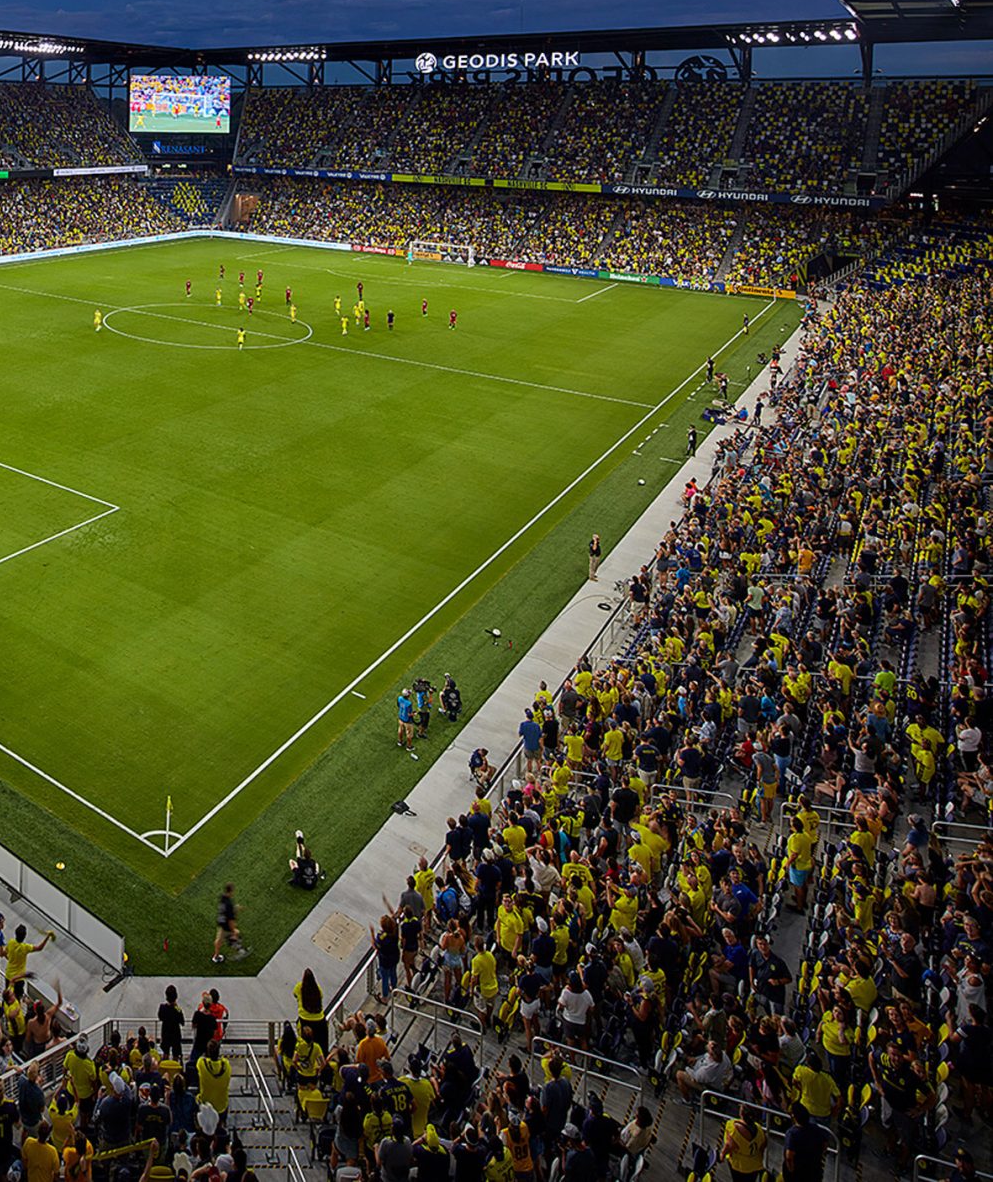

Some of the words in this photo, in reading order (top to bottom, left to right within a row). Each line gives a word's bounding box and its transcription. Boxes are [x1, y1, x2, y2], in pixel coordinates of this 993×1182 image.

[443, 53, 518, 69] GEODIS
[524, 51, 579, 67] PARK
[161, 145, 205, 154] RENASANT
[632, 187, 677, 196] HYUNDAI
[718, 192, 768, 200] HYUNDAI
[814, 196, 870, 206] HYUNDAI
[391, 1094, 407, 1112] 18
